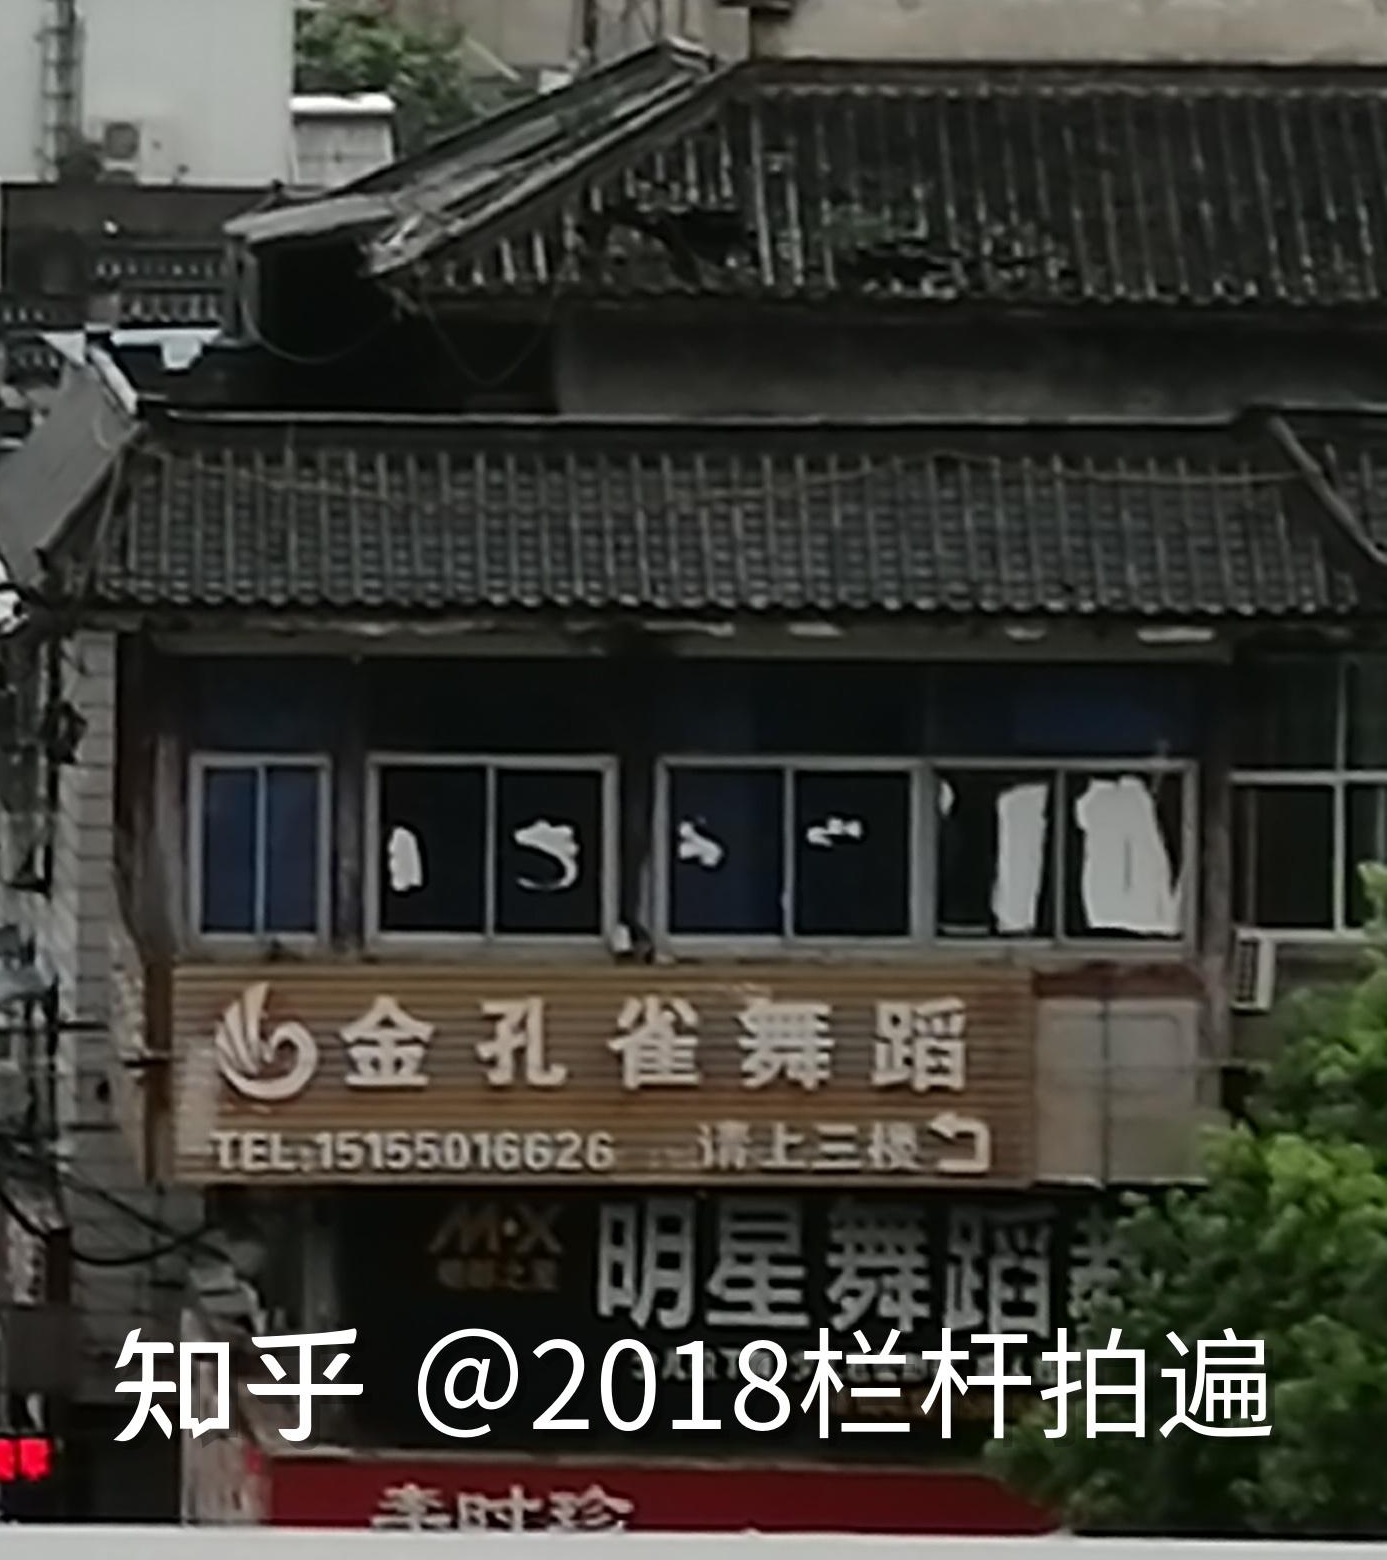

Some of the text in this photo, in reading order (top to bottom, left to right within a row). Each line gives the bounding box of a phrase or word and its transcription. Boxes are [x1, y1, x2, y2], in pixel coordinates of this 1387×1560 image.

[339, 995, 967, 1092] 金孔雀舞蹈
[210, 1130, 616, 1172] TEL:15155016626
[697, 1121, 926, 1171] 请上三楼
